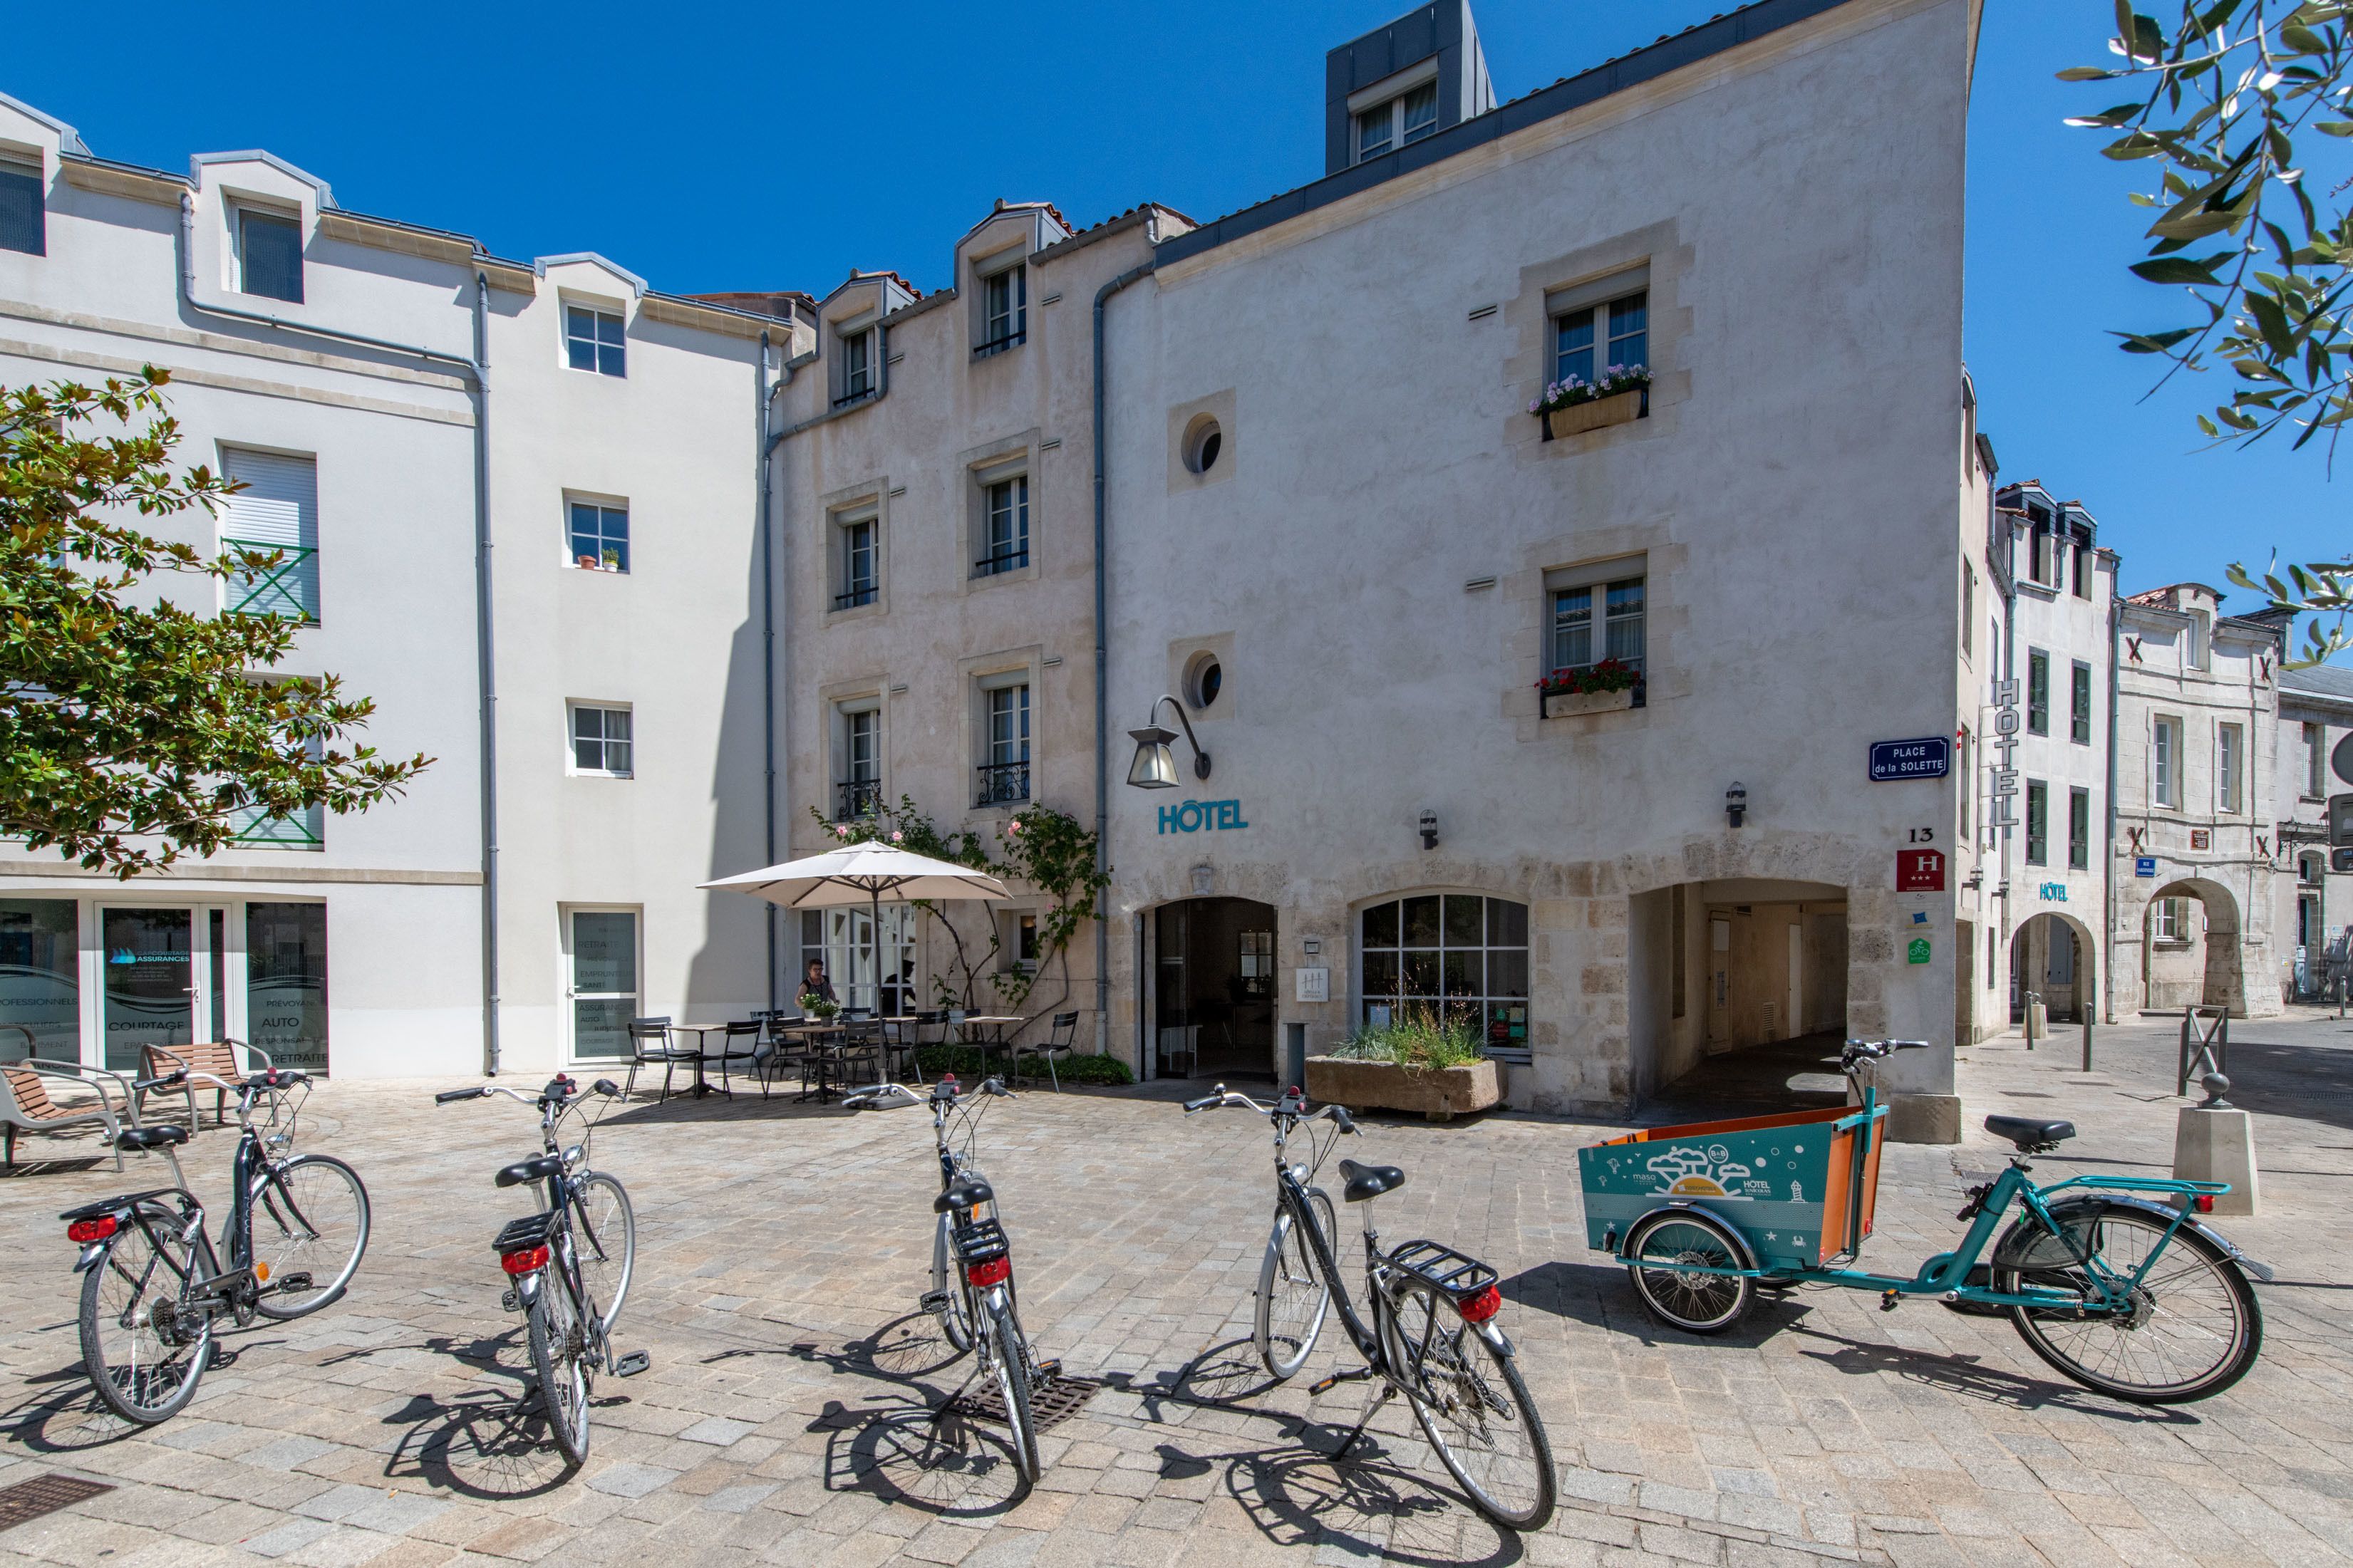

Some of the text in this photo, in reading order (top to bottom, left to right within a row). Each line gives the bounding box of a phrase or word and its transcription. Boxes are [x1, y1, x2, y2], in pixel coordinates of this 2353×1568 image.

[1893, 747, 1925, 757] PLACE
[1995, 677, 2020, 826] HOTEL
[1875, 759, 1943, 773] de la SOLETTE
[1159, 799, 1248, 834] HÔTEL
[1909, 828, 1933, 843] 13
[1916, 856, 1939, 871] H
[2039, 882, 2068, 902] HÔTEL
[261, 1017, 299, 1027] AUTO
[272, 1054, 328, 1064] RETRAITE
